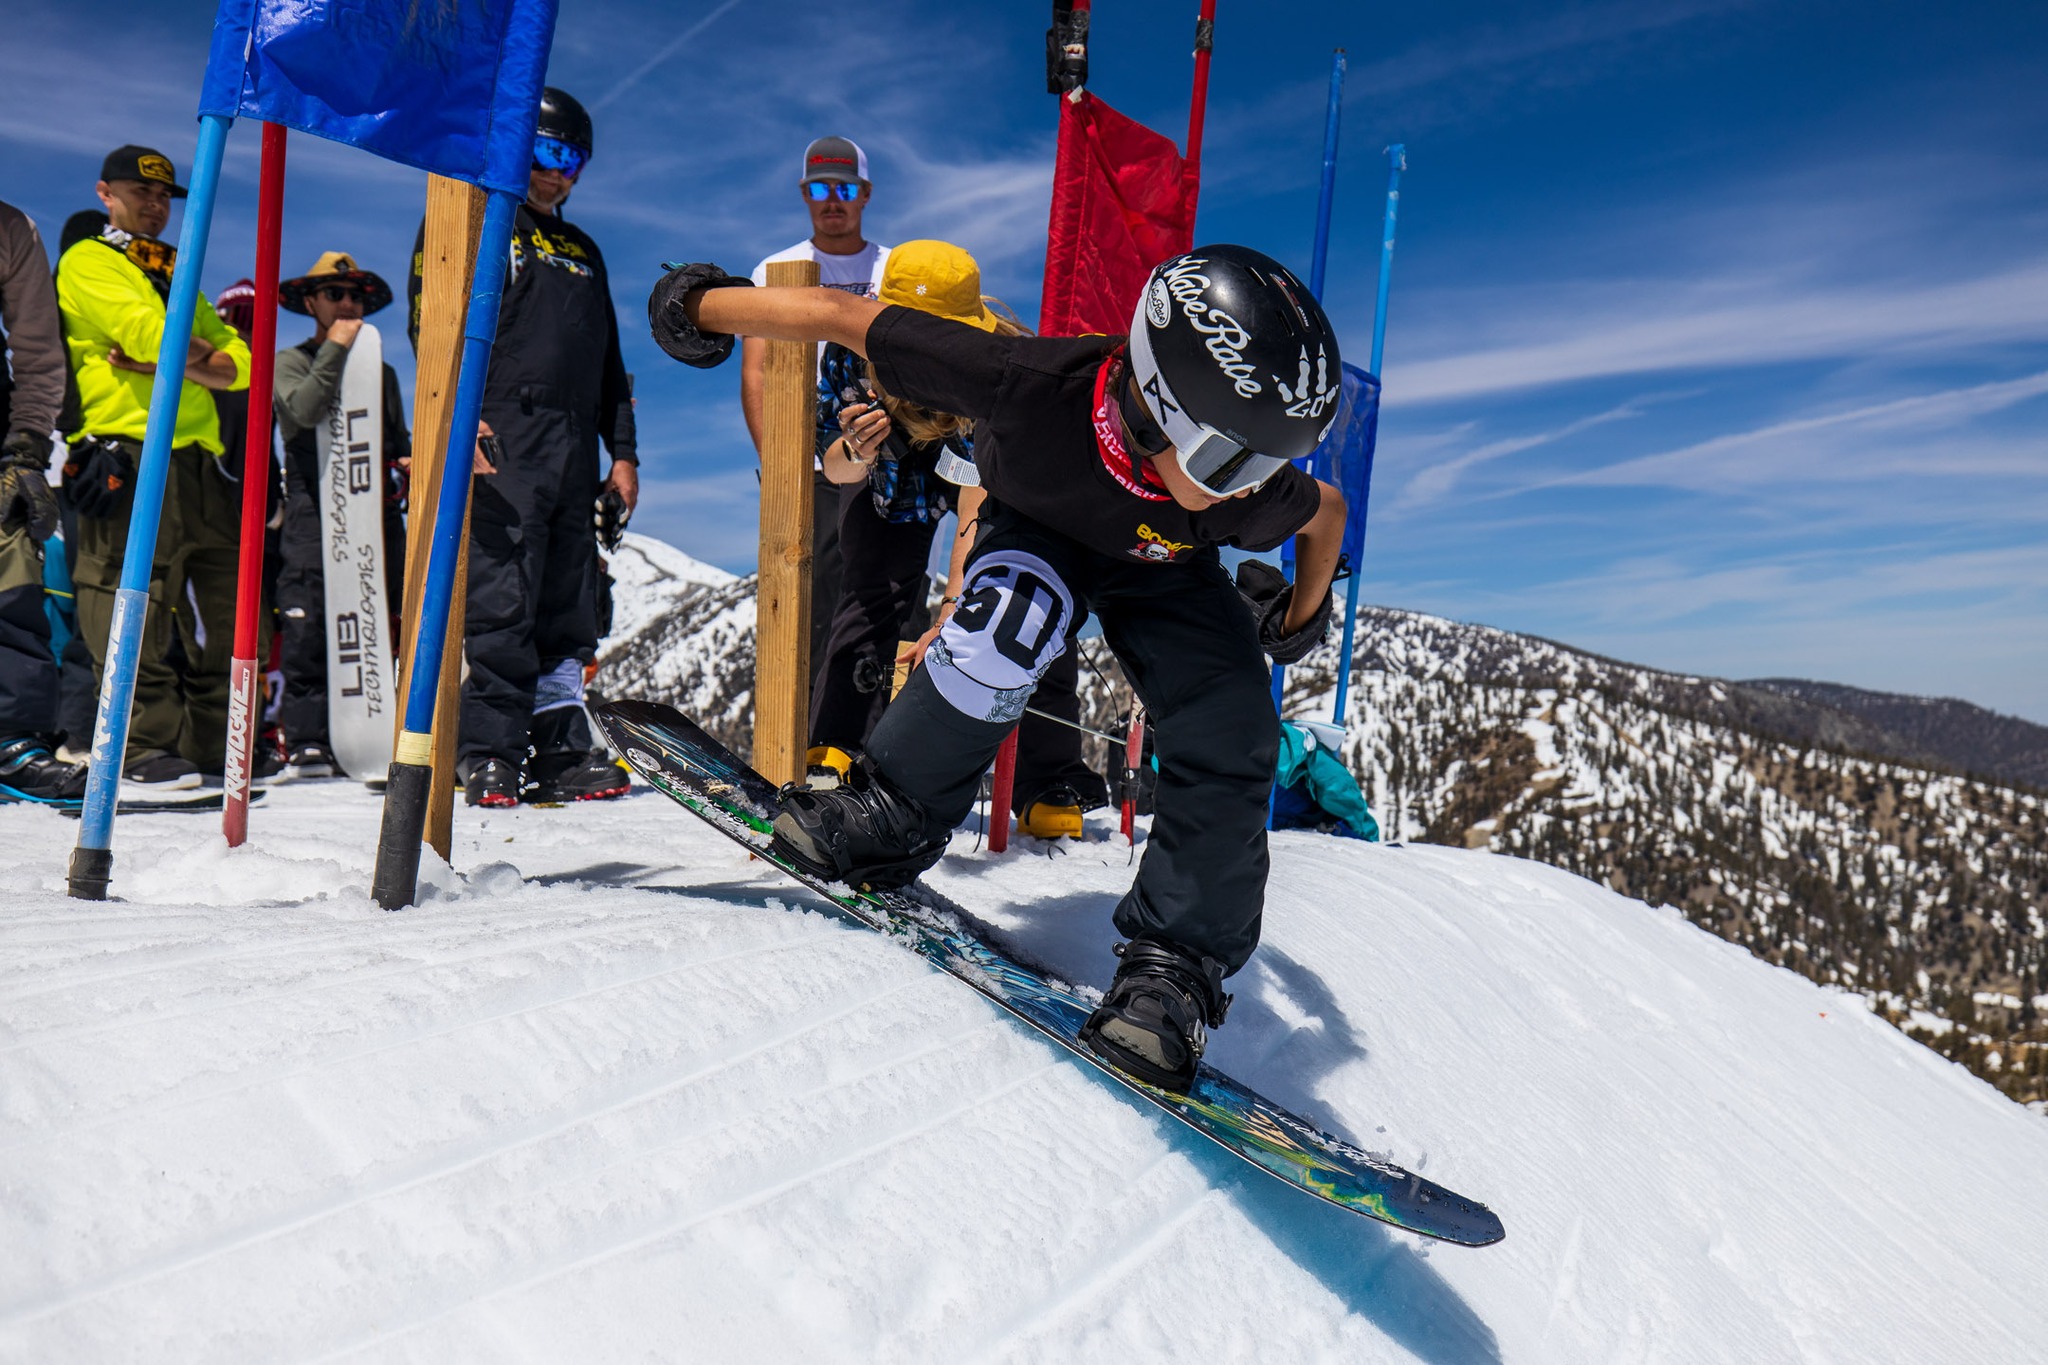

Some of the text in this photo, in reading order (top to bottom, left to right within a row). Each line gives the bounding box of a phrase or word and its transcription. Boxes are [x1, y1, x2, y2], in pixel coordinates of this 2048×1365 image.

[1163, 255, 1262, 399] Wave Rave
[346, 408, 371, 495] LIB
[337, 611, 364, 698] LIB
[357, 544, 382, 718] TECHNOLOGIES
